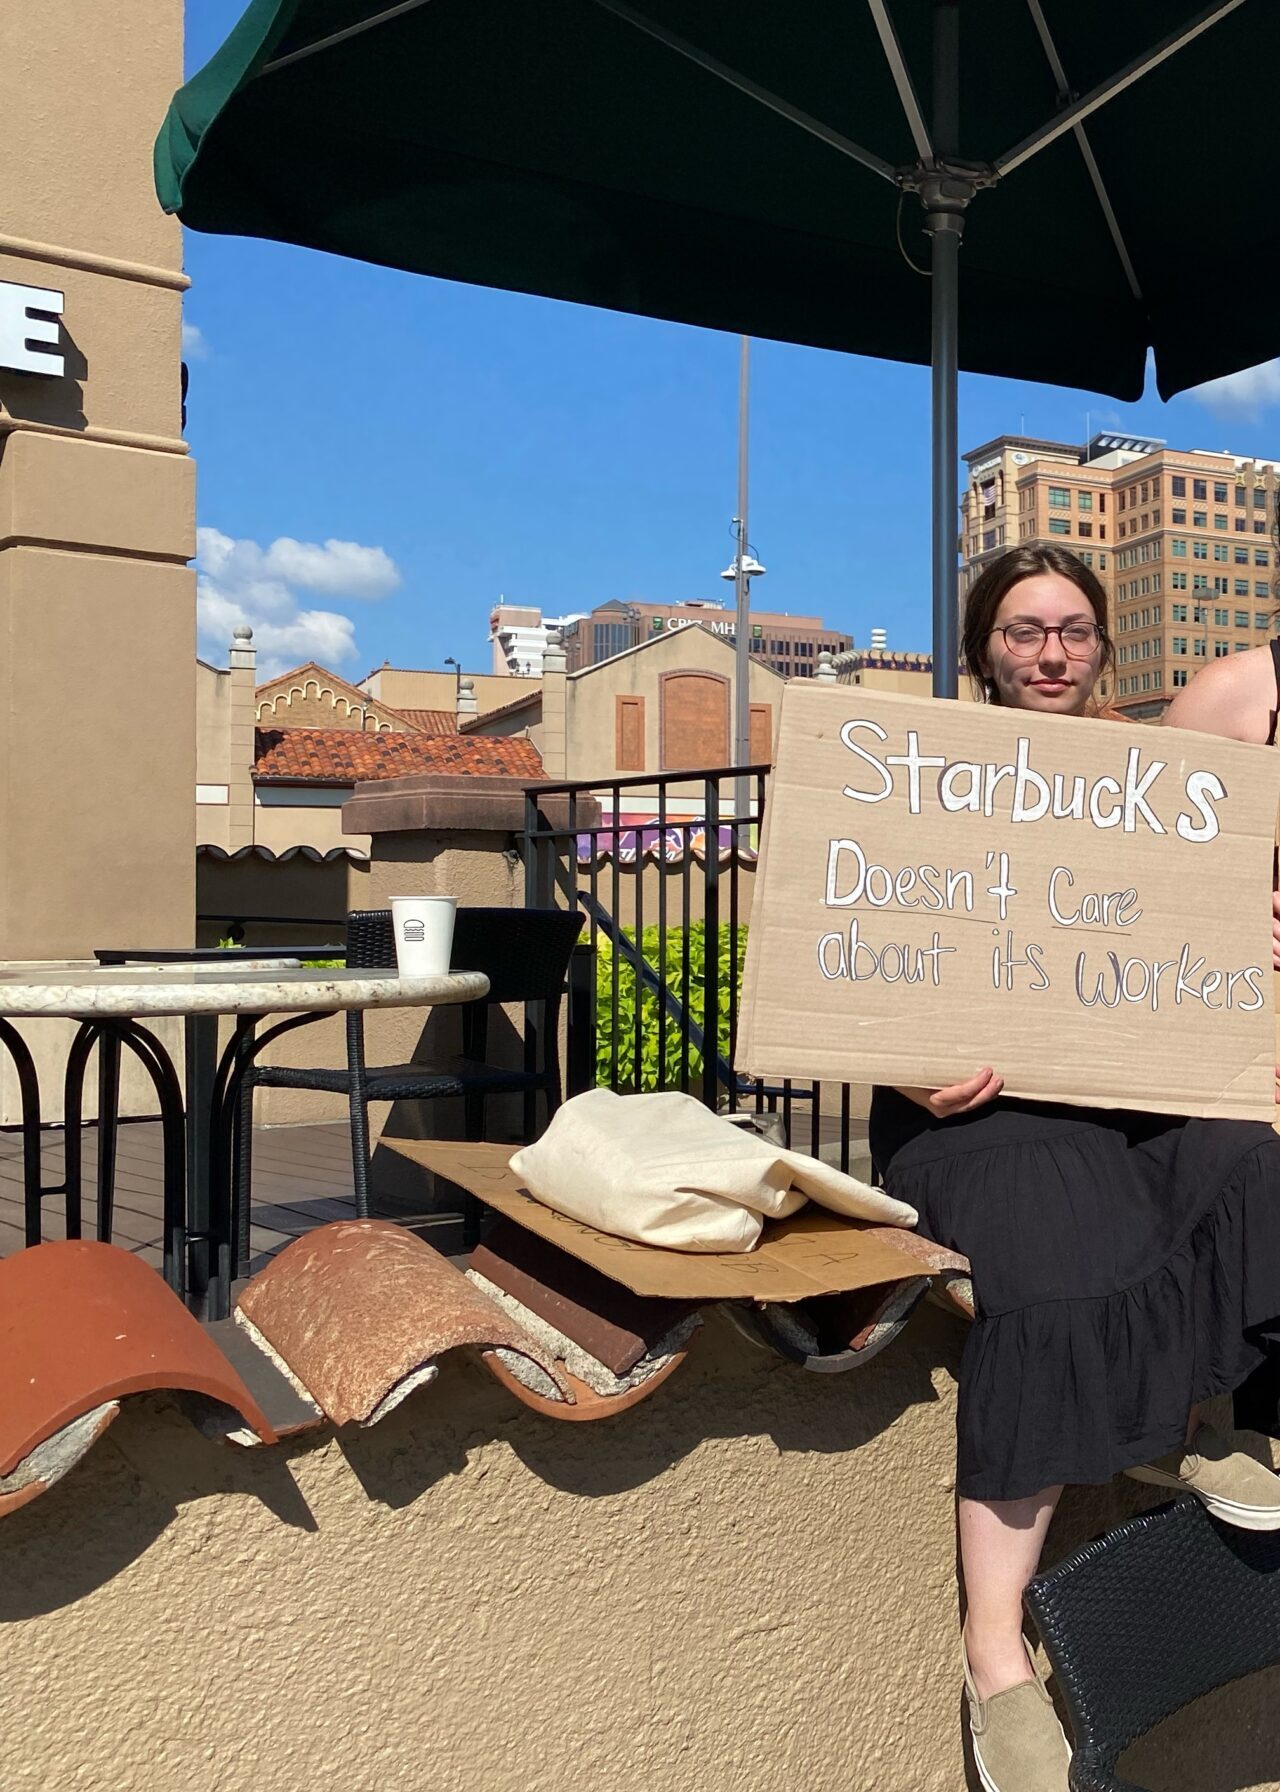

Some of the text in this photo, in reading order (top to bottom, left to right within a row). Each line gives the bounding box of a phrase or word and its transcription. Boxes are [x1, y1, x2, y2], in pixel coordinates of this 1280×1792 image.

[825, 838, 1143, 927] Doesn't Care
[817, 917, 957, 986] about
[992, 928, 1050, 990] its
